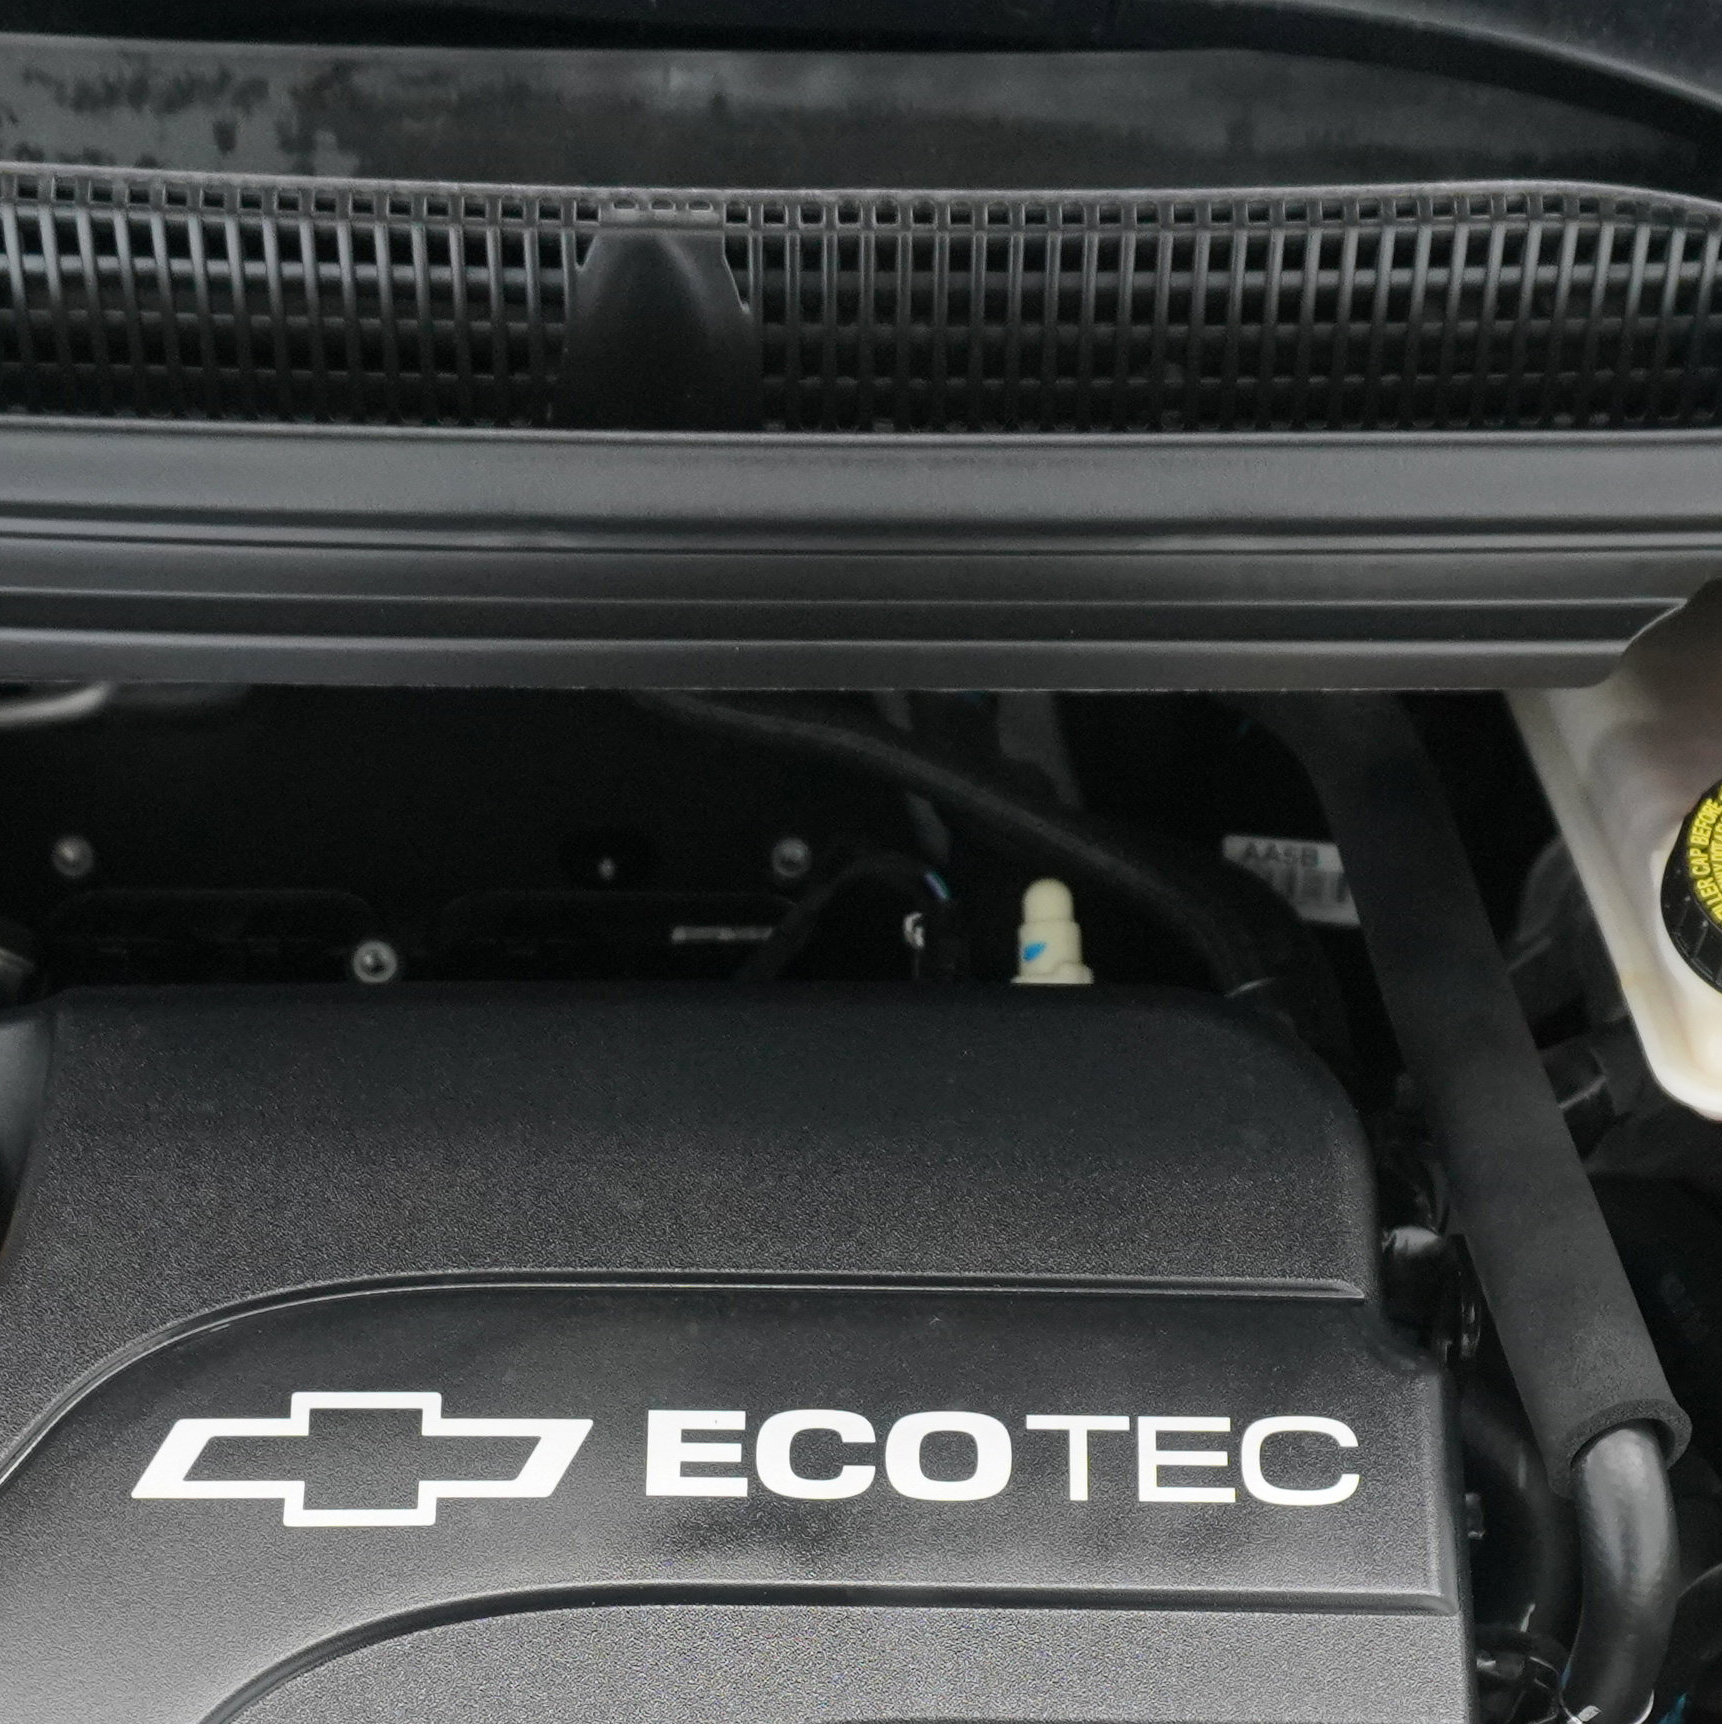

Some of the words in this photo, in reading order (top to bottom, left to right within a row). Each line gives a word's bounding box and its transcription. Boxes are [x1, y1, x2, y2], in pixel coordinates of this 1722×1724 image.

[1692, 799, 1722, 845] BEFORE
[1690, 849, 1711, 874] CAP
[645, 1410, 1360, 1507] ECOTEC
